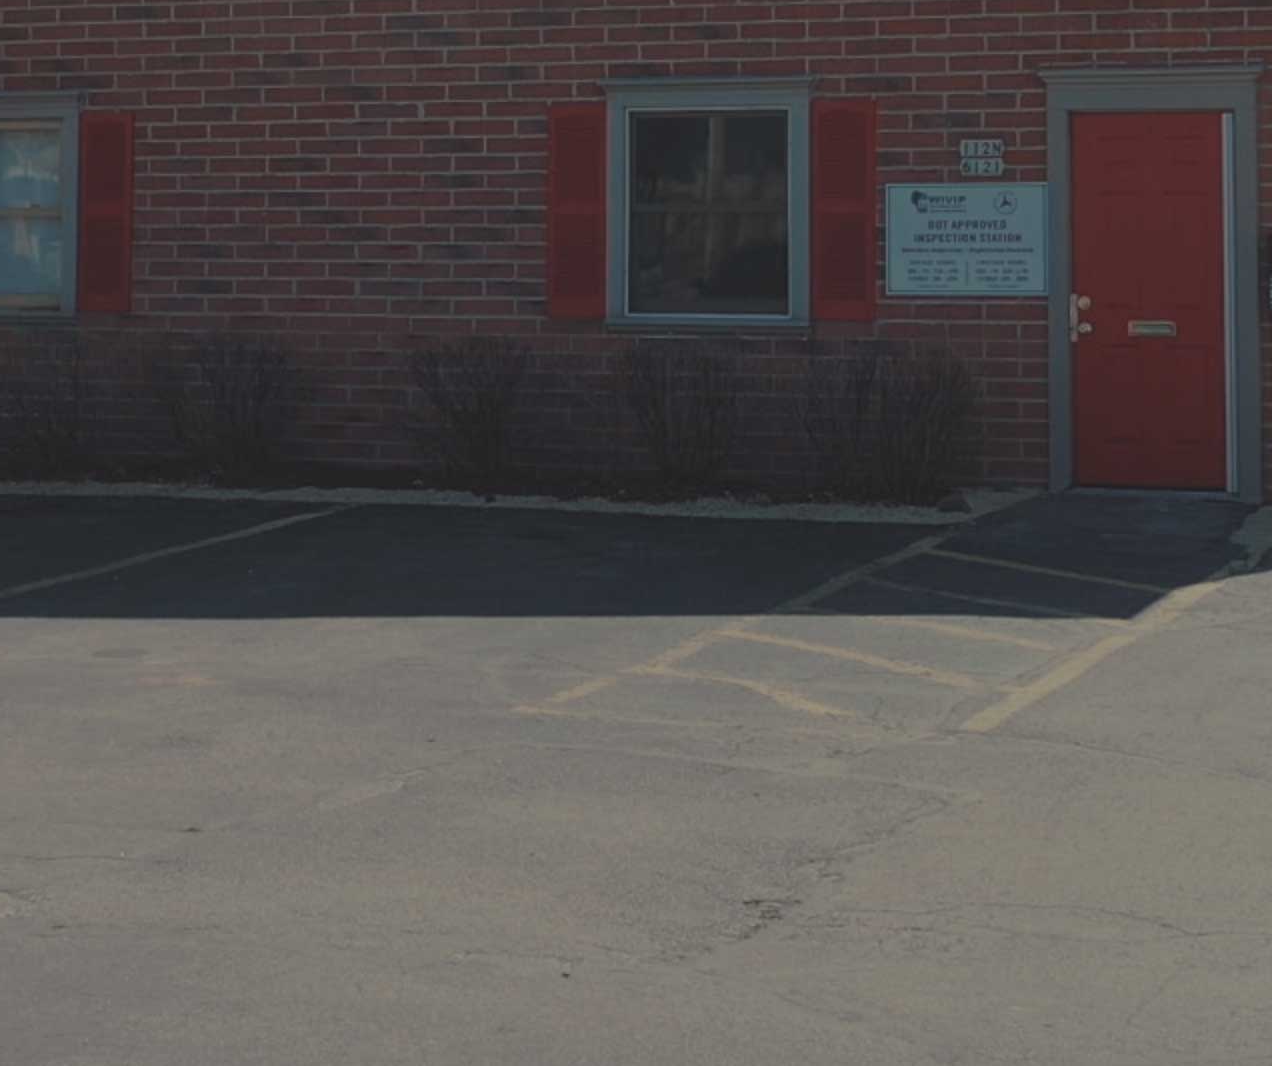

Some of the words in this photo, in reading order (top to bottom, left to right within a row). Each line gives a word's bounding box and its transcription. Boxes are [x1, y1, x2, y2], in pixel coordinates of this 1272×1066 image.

[928, 220, 948, 230] DOT
[951, 220, 1007, 230] APPROVED
[913, 233, 977, 243] INSPECTION
[980, 233, 1023, 243] STATION
